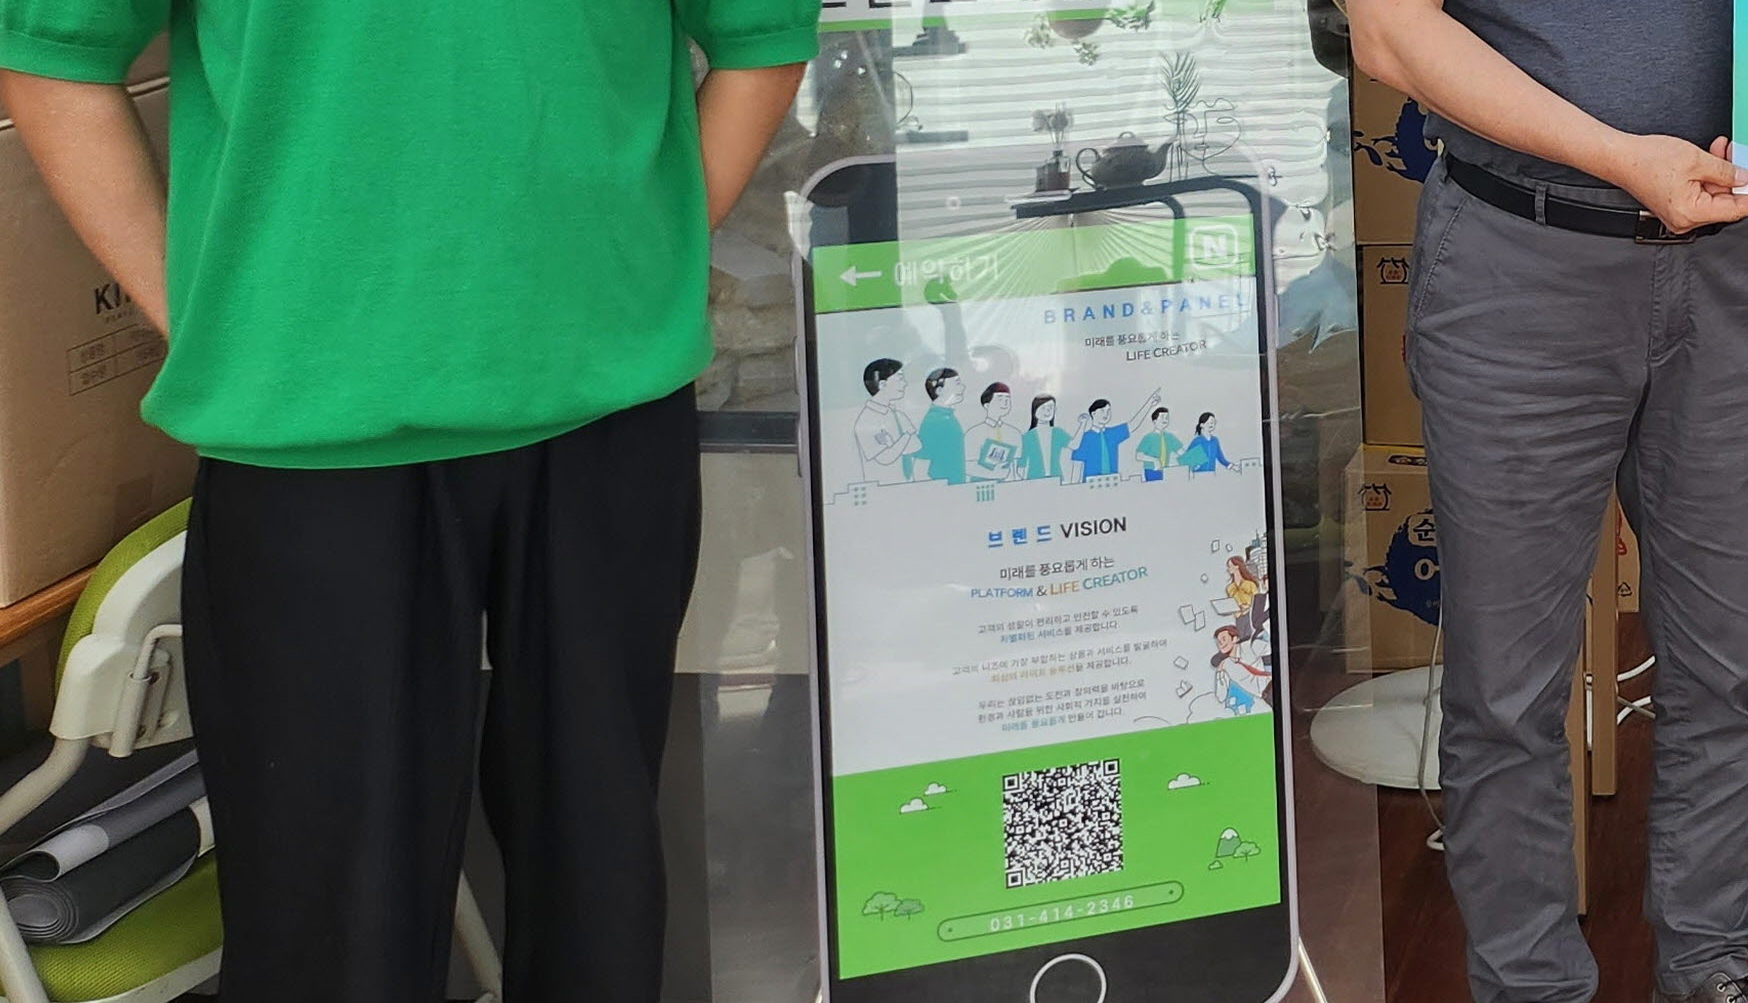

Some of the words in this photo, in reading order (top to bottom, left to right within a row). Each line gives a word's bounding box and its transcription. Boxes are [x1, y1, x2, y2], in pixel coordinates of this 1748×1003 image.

[1126, 347, 1152, 362] LIFE
[1060, 516, 1127, 539] VISION
[1000, 565, 1036, 581] 미래를
[1039, 558, 1088, 577] 풍요롭게
[1090, 555, 1115, 570] 하는
[970, 587, 1034, 599] PLATFORM
[1036, 584, 1048, 597] &
[1050, 580, 1080, 596] LIFE
[1082, 566, 1149, 590] CREATOR
[990, 894, 1134, 933] 031-414-2346
